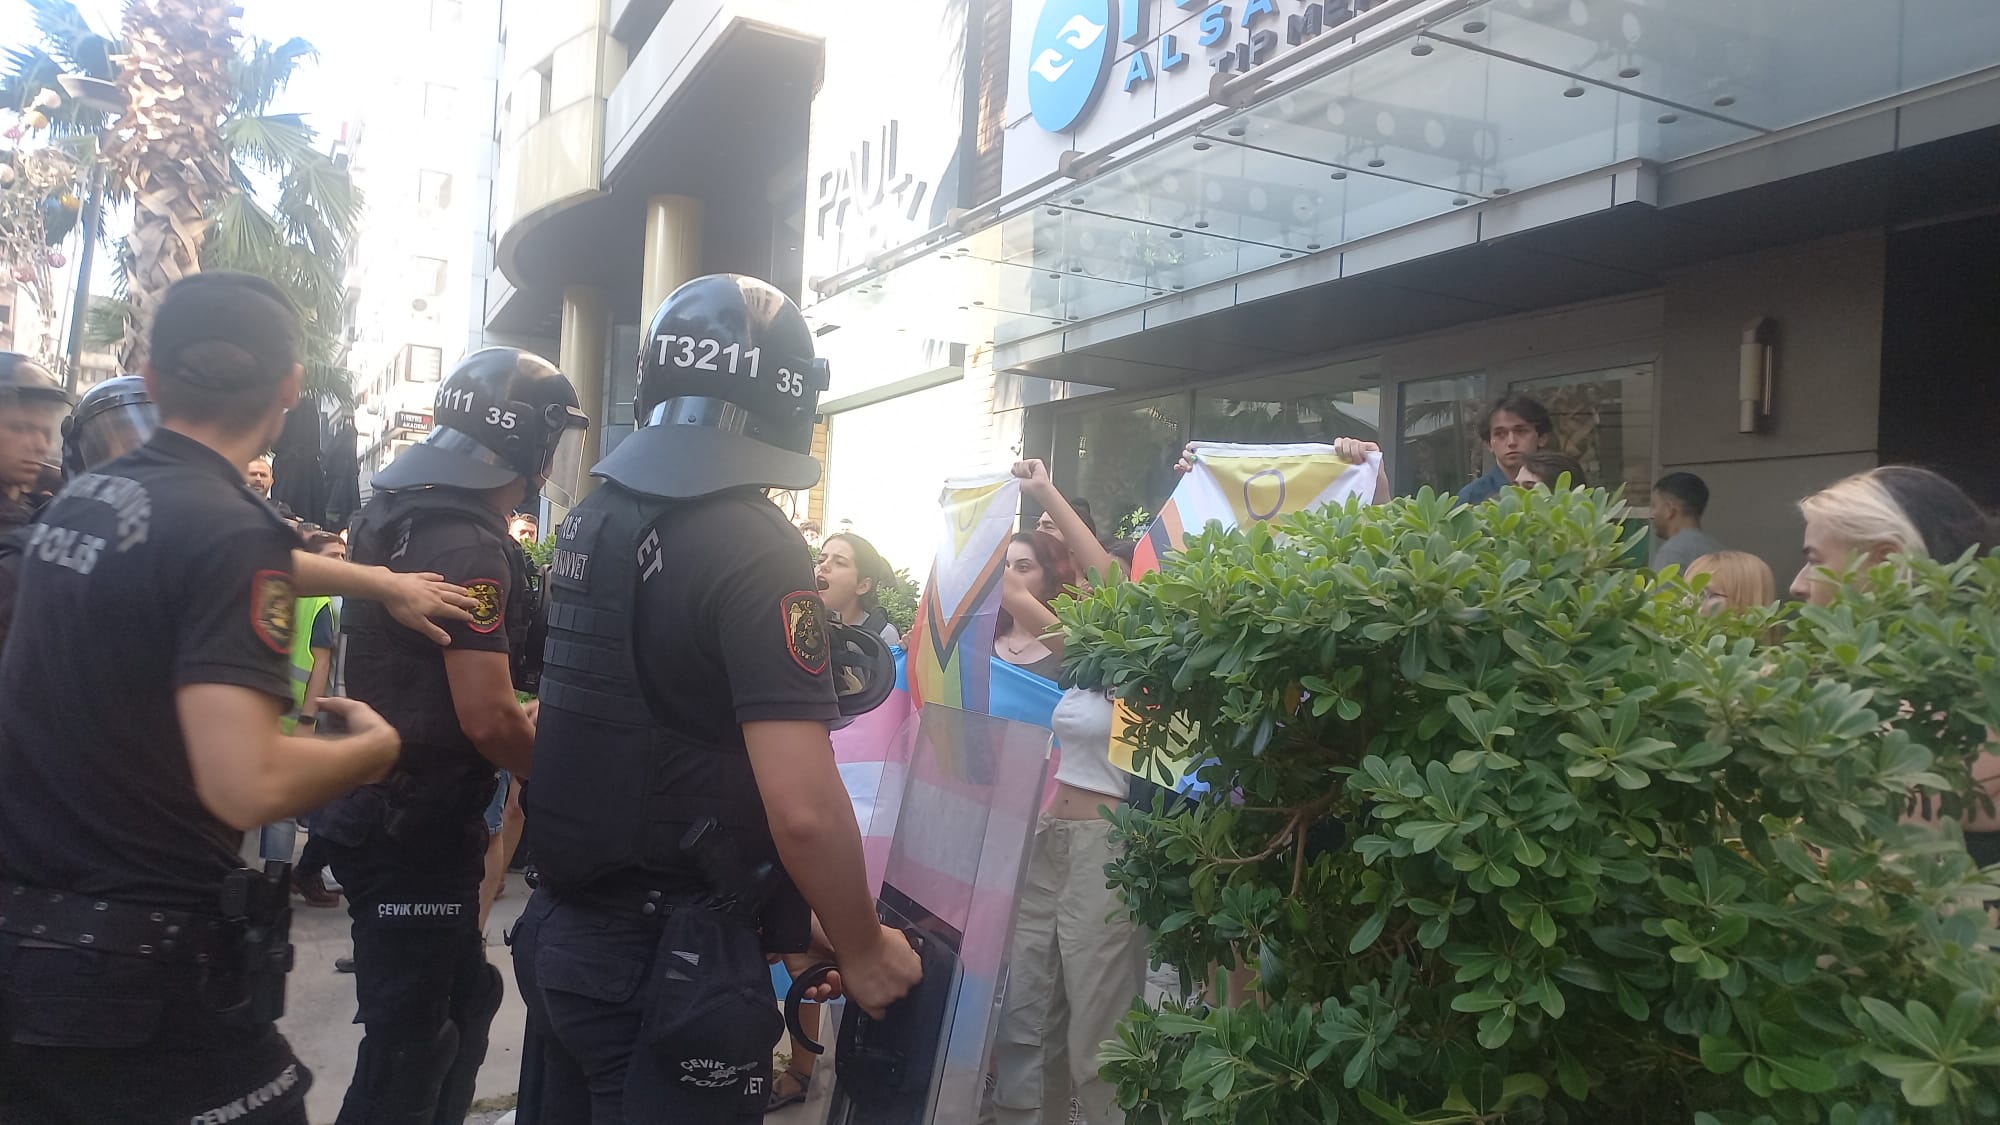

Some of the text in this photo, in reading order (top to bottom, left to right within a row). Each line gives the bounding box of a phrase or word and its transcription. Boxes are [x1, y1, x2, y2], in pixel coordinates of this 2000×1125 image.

[656, 334, 761, 379] T3211
[776, 367, 804, 398] 35
[485, 406, 517, 430] 35
[378, 903, 461, 918] ÇEVİK KUVVET
[680, 1058, 728, 1072] ÇEVİK
